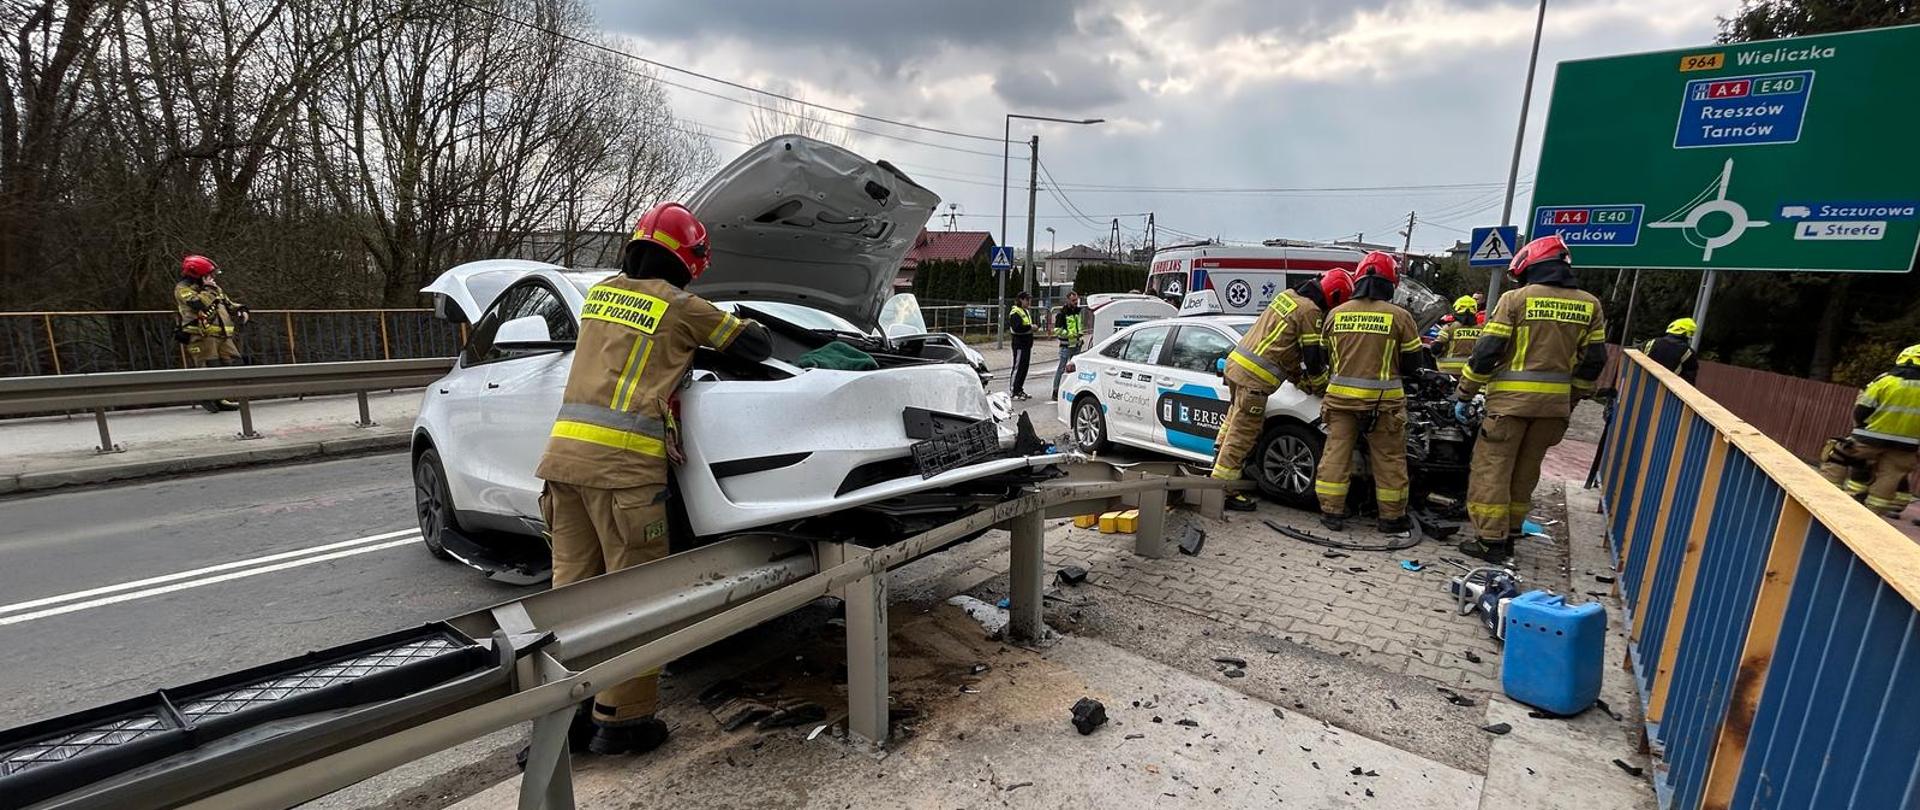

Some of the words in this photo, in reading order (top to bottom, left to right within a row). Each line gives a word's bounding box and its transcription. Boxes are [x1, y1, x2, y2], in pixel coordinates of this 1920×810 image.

[1687, 56, 1717, 70] 964
[1736, 45, 1836, 66] Wieliczka
[1700, 102, 1784, 119] Rzeszów
[1701, 123, 1774, 139] Tarnów
[1819, 205, 1915, 217] Szczurowa
[1825, 224, 1880, 236] Strefa
[1183, 298, 1204, 310] Uber
[1107, 388, 1124, 401] Uber
[1124, 391, 1150, 407] Comfort
